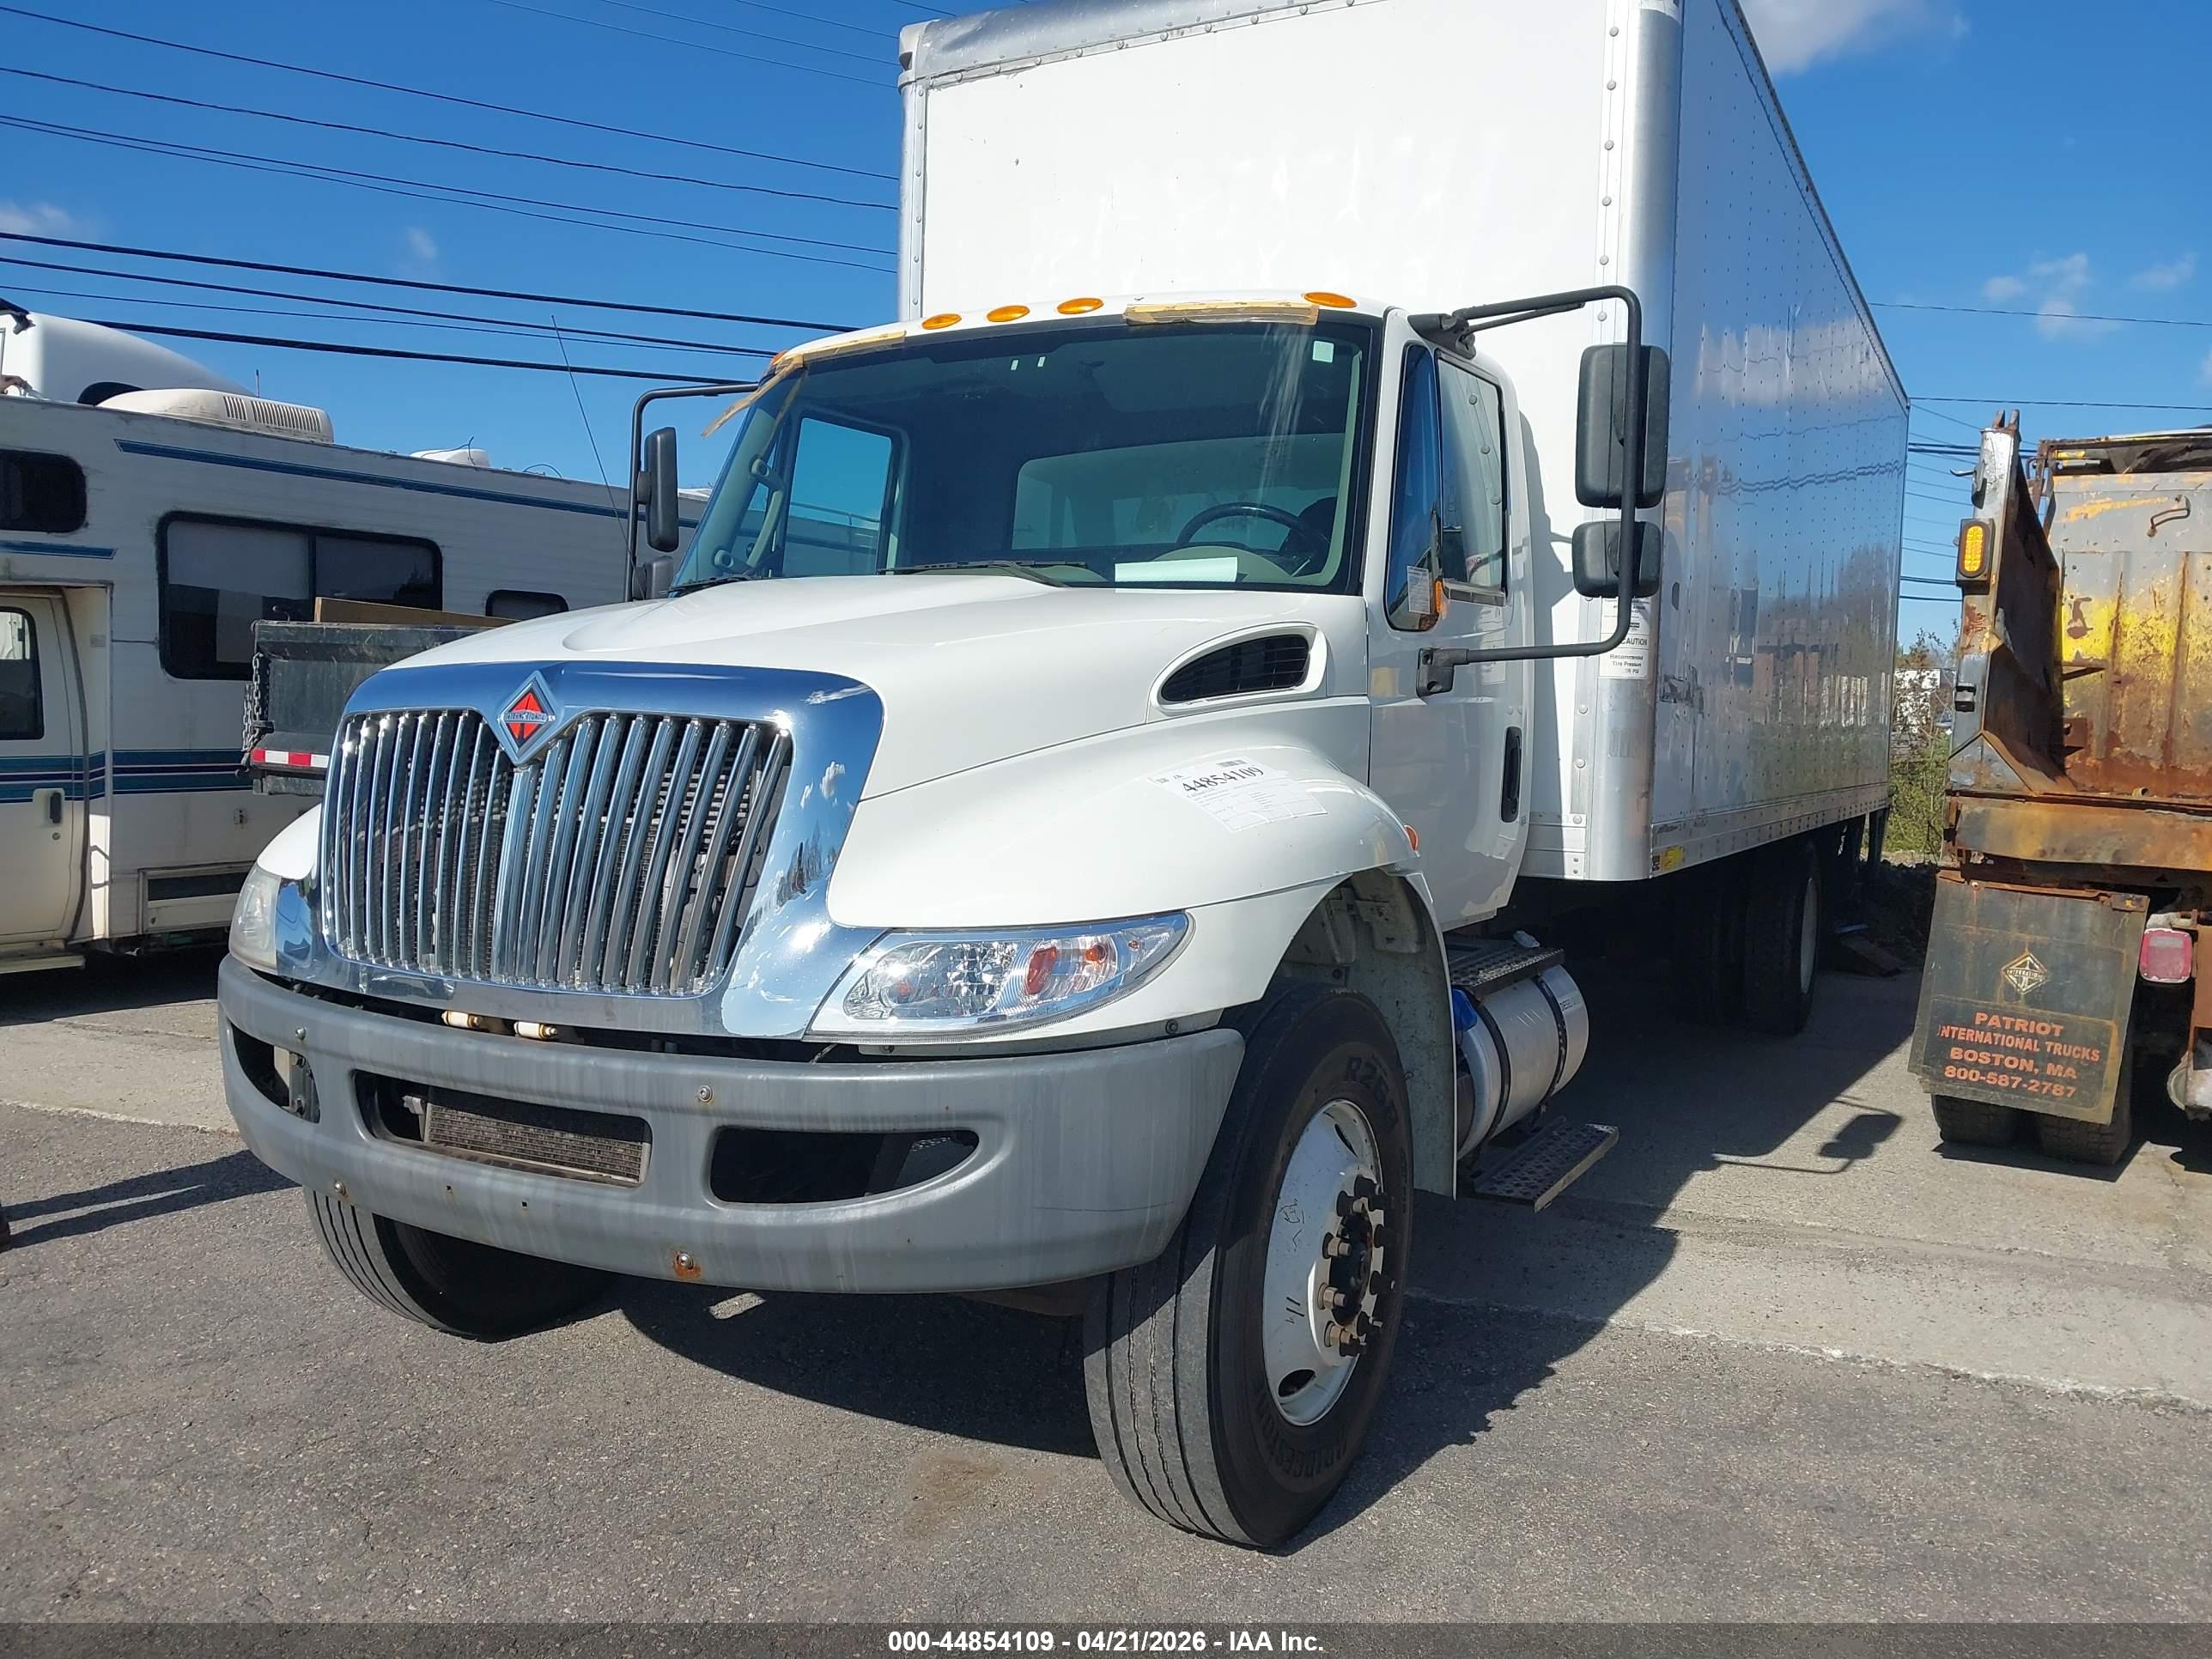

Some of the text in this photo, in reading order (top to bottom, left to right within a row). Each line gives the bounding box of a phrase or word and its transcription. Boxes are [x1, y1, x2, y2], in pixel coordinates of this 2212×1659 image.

[1182, 767, 1263, 791] 44854109
[1975, 1012, 2064, 1037] PATRIOT
[1937, 1024, 2101, 1062] INTERNATIONAL TRUCKS
[1950, 1047, 2078, 1079] BOSTON, MA
[1944, 1065, 2076, 1098] 800-587-2787
